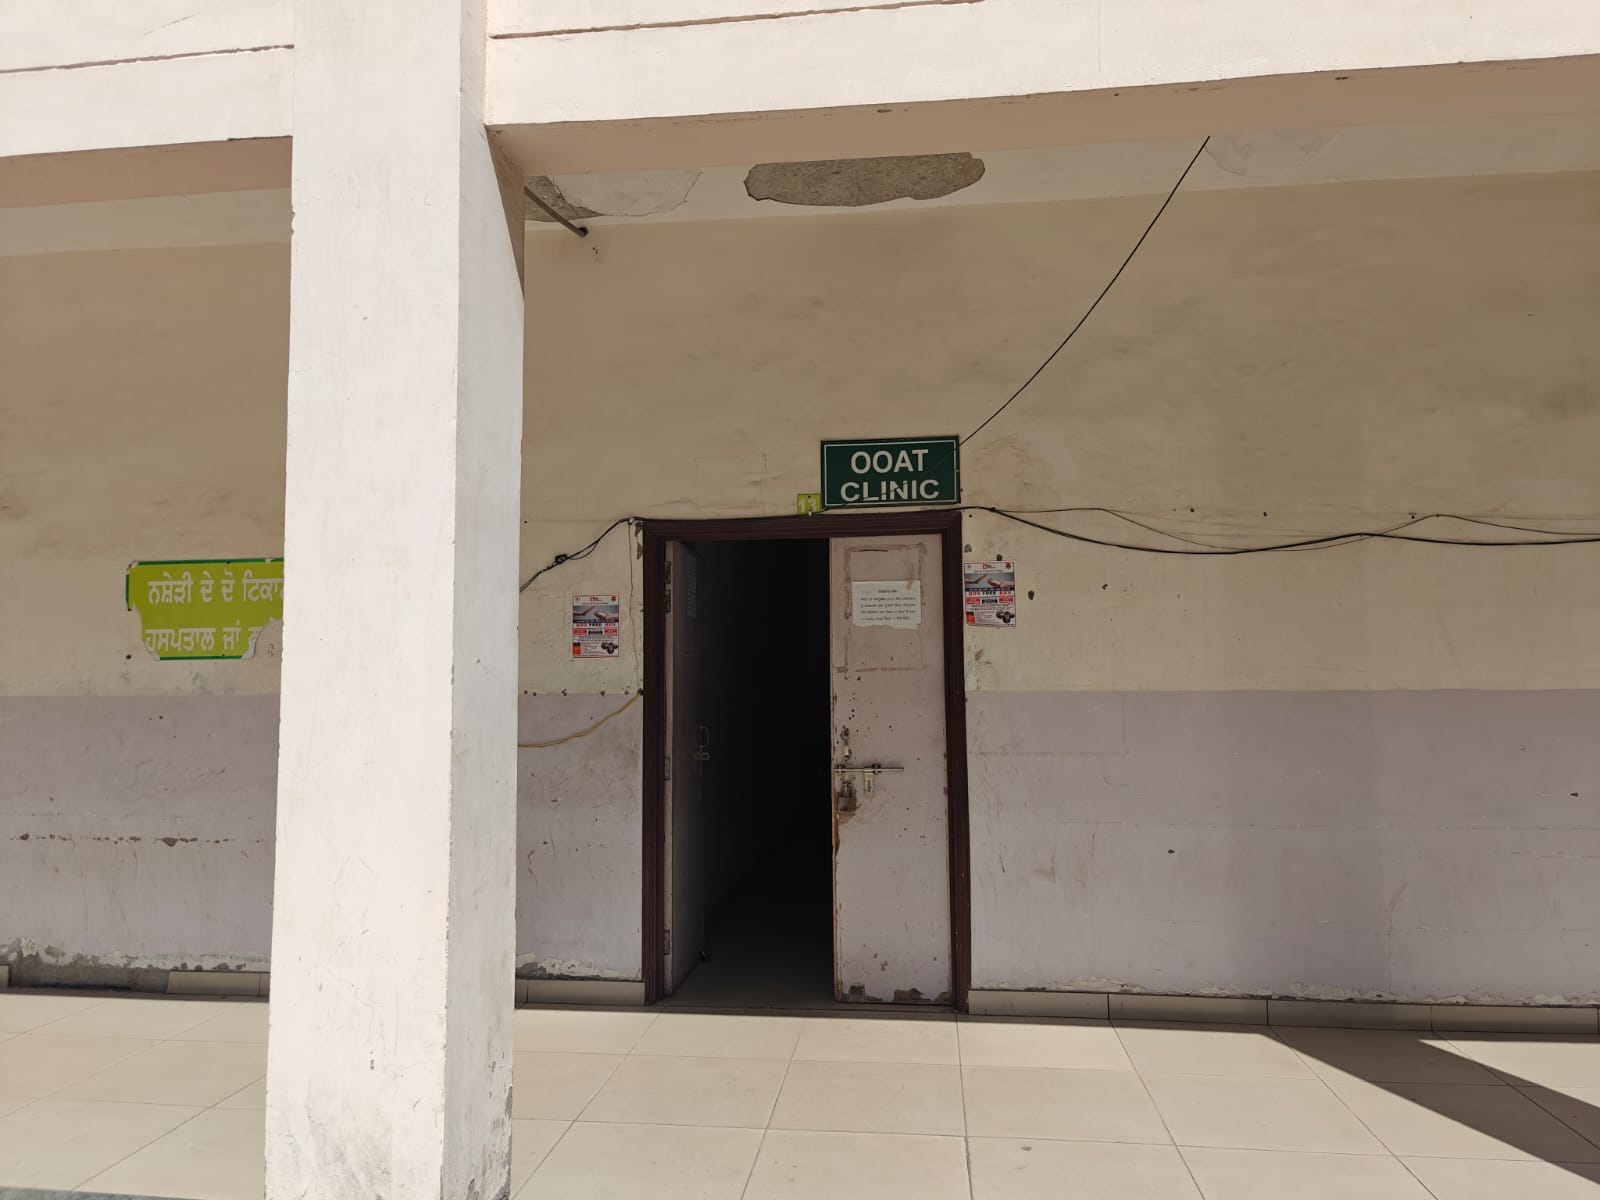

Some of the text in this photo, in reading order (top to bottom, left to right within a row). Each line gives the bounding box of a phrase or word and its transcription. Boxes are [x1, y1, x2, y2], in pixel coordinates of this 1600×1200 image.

[850, 448, 929, 475] OOAT
[840, 479, 940, 503] CLINIC
[200, 570, 215, 604] ਦੇ
[221, 568, 235, 603] ਦੋ
[144, 626, 216, 652] ਹਸਪਤਾਲ
[222, 619, 242, 651] ਜਾਂ
